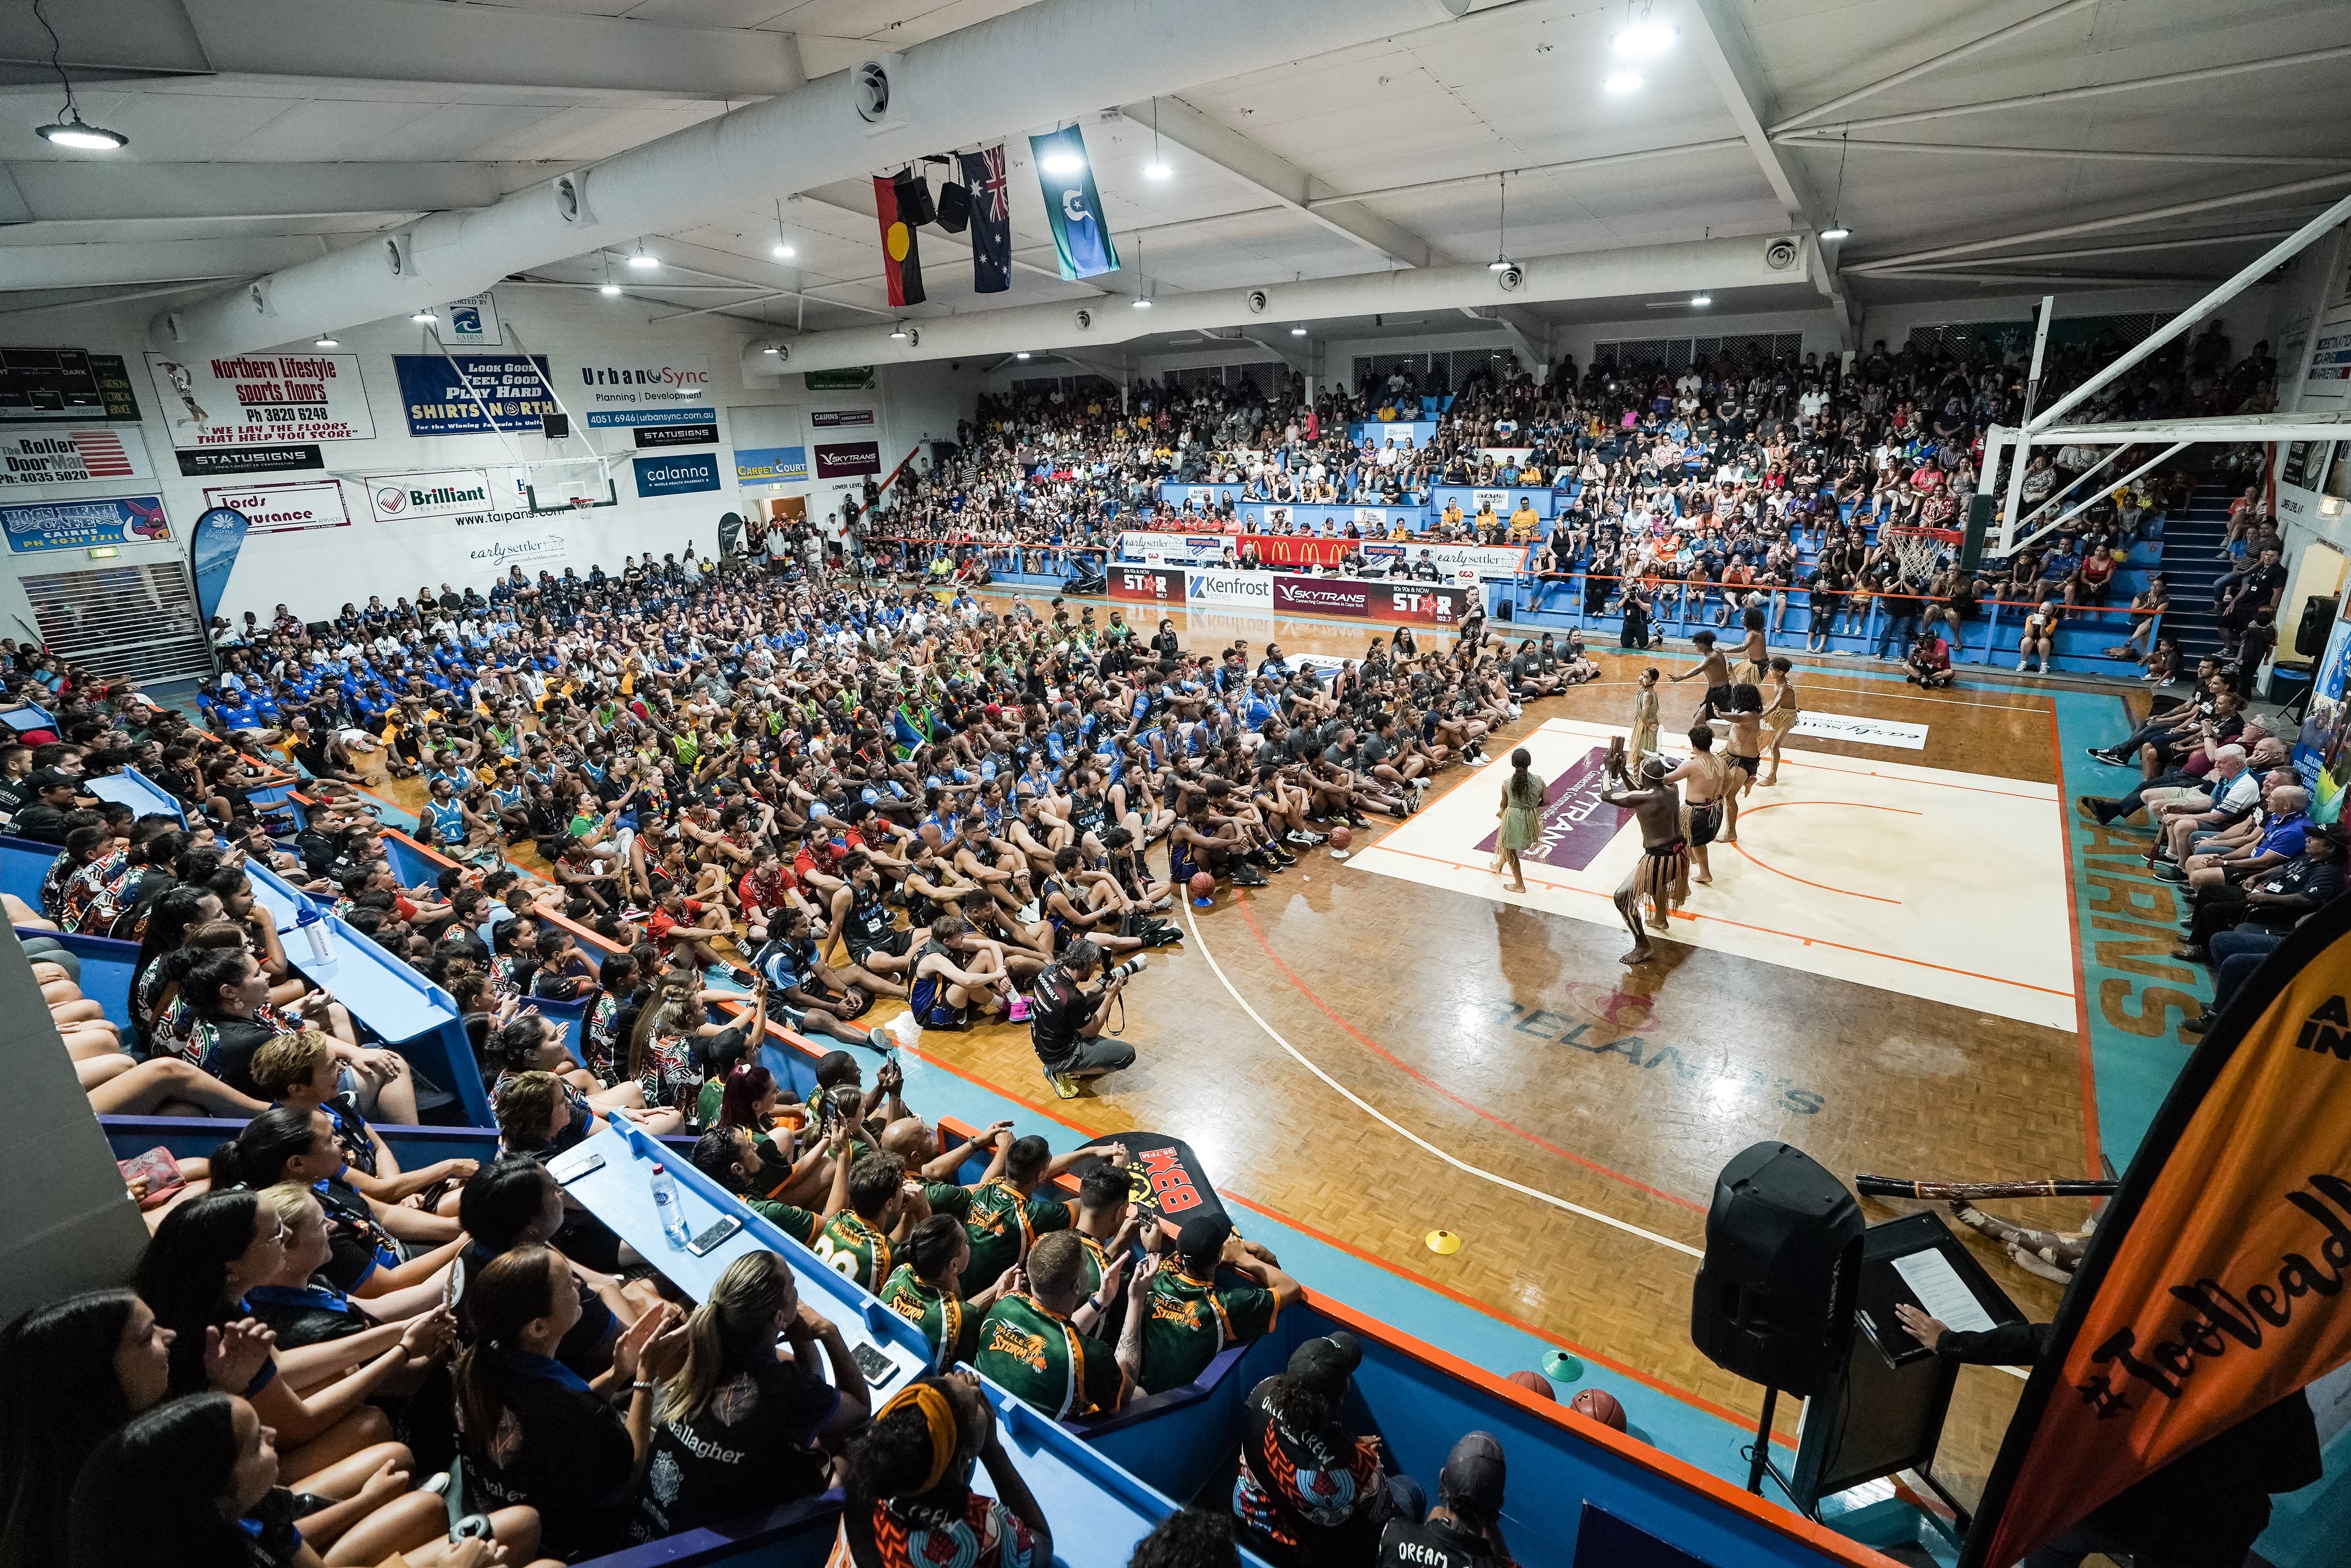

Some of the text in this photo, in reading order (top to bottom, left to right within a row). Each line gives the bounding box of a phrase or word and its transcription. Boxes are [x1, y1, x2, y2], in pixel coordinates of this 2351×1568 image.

[211, 357, 337, 382] Northern Lifestyle
[461, 374, 540, 386] FEEL GOOD
[236, 381, 327, 404] sports floors
[496, 386, 542, 398] HARD
[596, 391, 702, 402] Planning Development
[246, 407, 328, 422] Ph 3820 6248
[411, 403, 480, 419] SHIRTS
[591, 414, 611, 424] 4051
[238, 422, 348, 434] LAY THE FLOORS
[644, 429, 709, 439] STATUSIGNS
[197, 434, 234, 444] THAT
[239, 433, 273, 442] HELP
[277, 432, 305, 440] YOU
[1, 438, 78, 456] The Roller
[5, 455, 87, 472] DoorMan
[195, 451, 307, 465] STATUSIGNS
[831, 453, 876, 463] SKYTRANS
[0, 470, 88, 484] Ph: 4035 5020
[647, 465, 708, 481] calanna
[737, 463, 806, 477] CARPET COURT
[222, 495, 266, 509] Lords
[409, 487, 485, 506] Brilliant
[56, 503, 123, 525] BREATH
[414, 501, 488, 512] TECHNOLOGIES
[38, 517, 96, 531] CAFE
[209, 527, 234, 535] Cairns
[23, 533, 120, 548] PH 4031 7711
[43, 529, 98, 538] CAIRNS
[205, 532, 237, 540] Regional
[1125, 536, 1169, 554] early settler
[1366, 547, 1404, 555] SPORTSWORLD
[470, 541, 542, 565] early settler
[507, 553, 566, 564] www.earlysettler.com.au
[1437, 550, 1469, 567] early
[1469, 553, 1500, 564] settler
[1206, 576, 1269, 596] Kenfrost
[1206, 592, 1231, 601] Homes
[1293, 590, 1366, 603] SKYTRANS
[2292, 759, 2309, 775] STRONG
[1574, 770, 1601, 796] Connecting
[1084, 811, 1112, 825] CAIRNS
[451, 828, 457, 837] 4
[1141, 1148, 1174, 1159] 98.7FM
[1144, 1154, 1203, 1214] BBM
[830, 1220, 866, 1249] MCCABE
[895, 1284, 924, 1307] RAZZLE
[2075, 1174, 2351, 1420] #TooDeadl
[893, 1295, 926, 1323] STORM
[1154, 1296, 1183, 1312] RAZZLE
[1151, 1305, 1186, 1326] STORM
[995, 1324, 1026, 1346] RAZZLE
[988, 1334, 1029, 1362] STORM
[668, 1418, 745, 1465] Gallagher
[1301, 1429, 1334, 1465] CREW
[1398, 1542, 1448, 1568] DREAM
